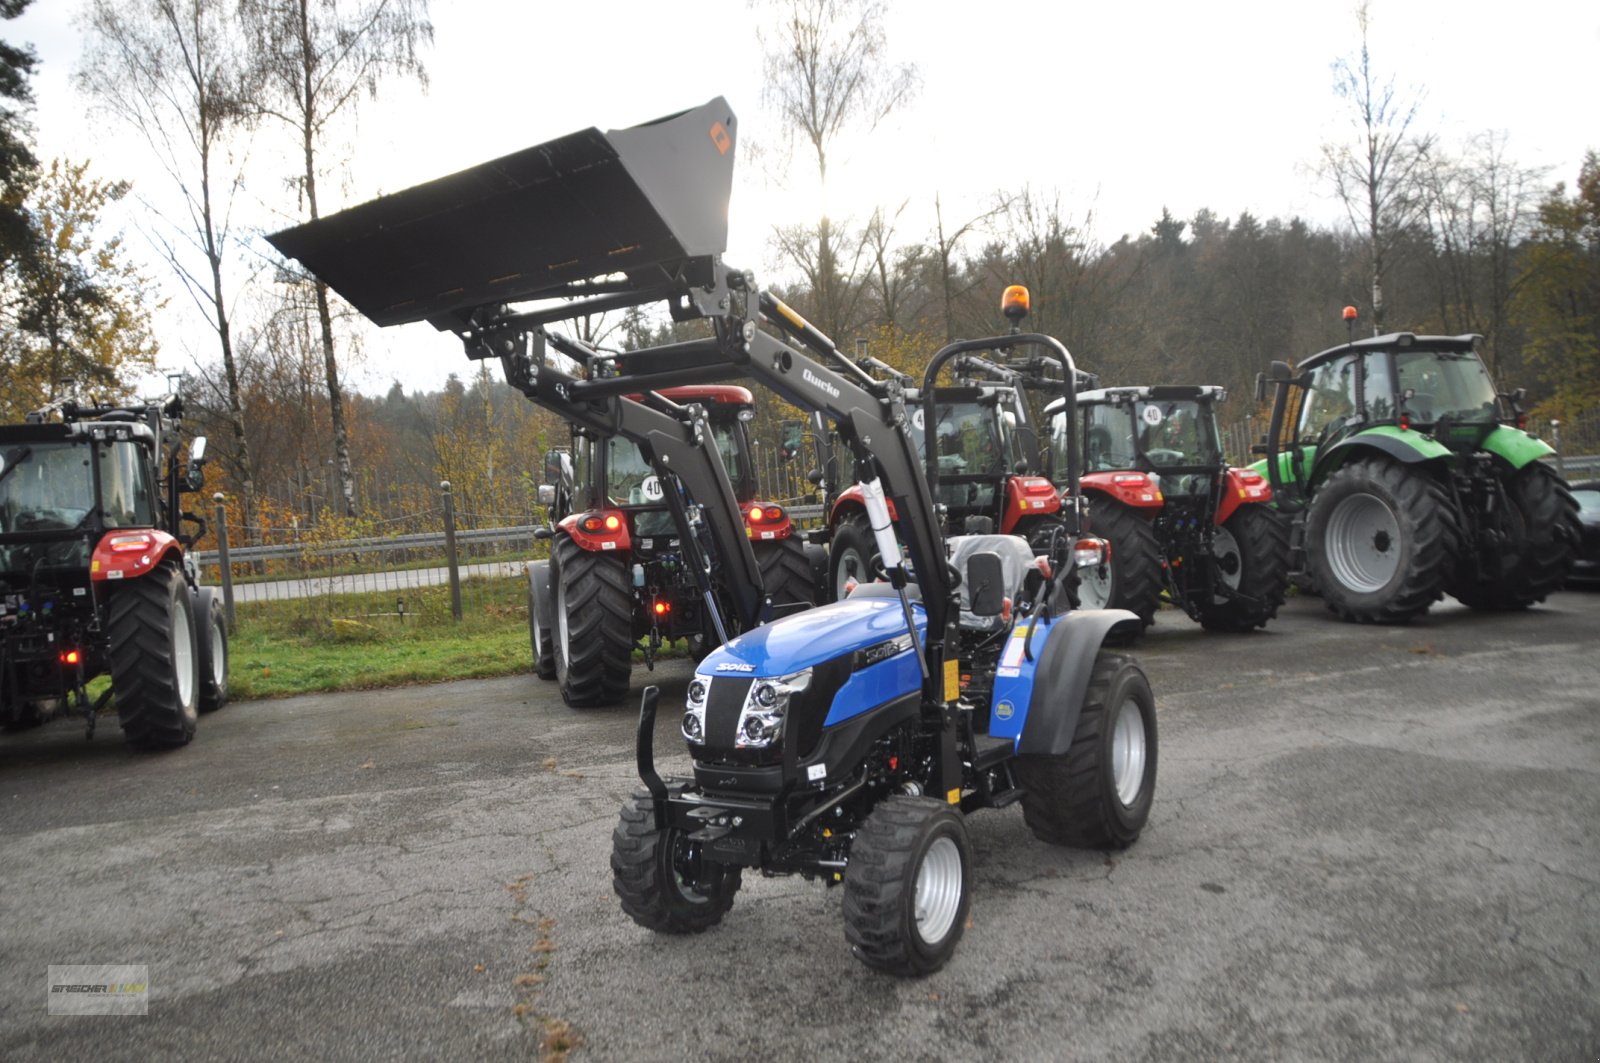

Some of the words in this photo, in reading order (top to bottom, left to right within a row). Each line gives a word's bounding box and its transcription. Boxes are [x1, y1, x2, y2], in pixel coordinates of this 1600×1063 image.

[803, 368, 840, 398] Quicke
[1147, 408, 1158, 421] 40
[646, 480, 661, 495] 40
